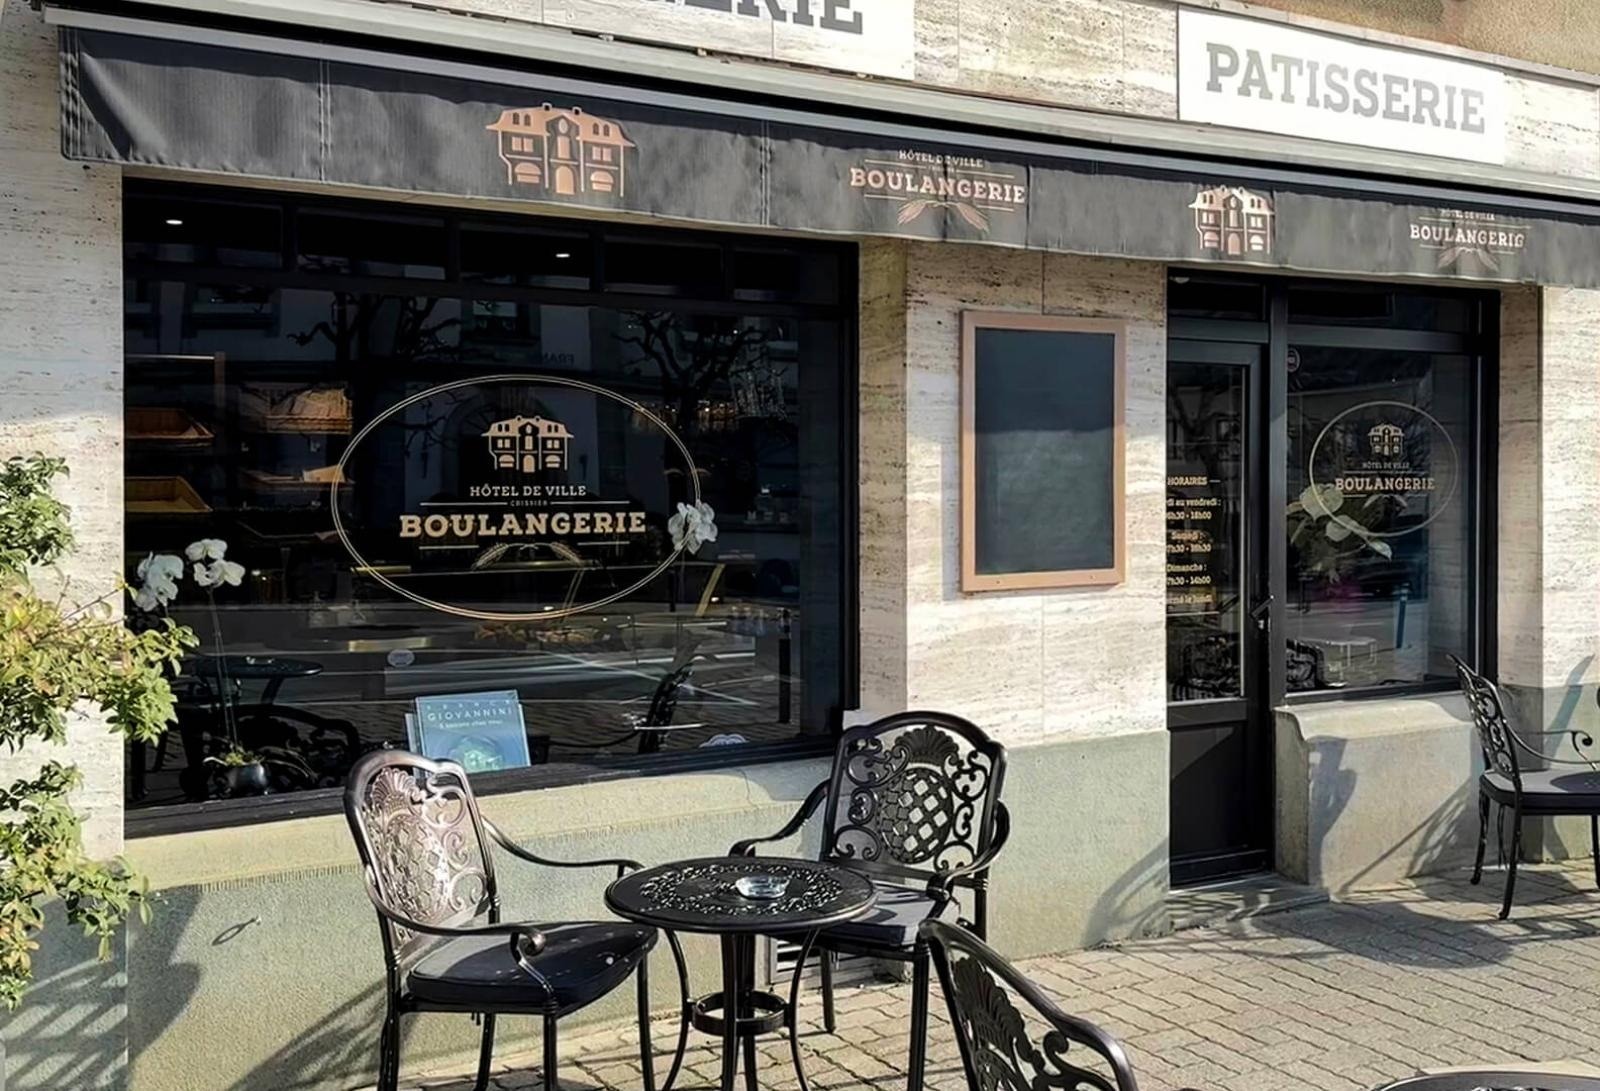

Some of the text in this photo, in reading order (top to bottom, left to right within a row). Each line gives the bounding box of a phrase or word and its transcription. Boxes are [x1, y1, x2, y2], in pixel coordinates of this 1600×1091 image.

[1206, 42, 1485, 134] PATISSERIE
[900, 150, 935, 163] HÔTEL
[952, 156, 984, 168] VILLE
[850, 167, 1026, 204] BOULANGERIE
[470, 483, 586, 497] HÔTEL DE VILLE
[1335, 477, 1435, 490] BOULANGERIE
[399, 511, 647, 538] BOULANGERIE
[427, 707, 512, 721] GIOVANNINI
